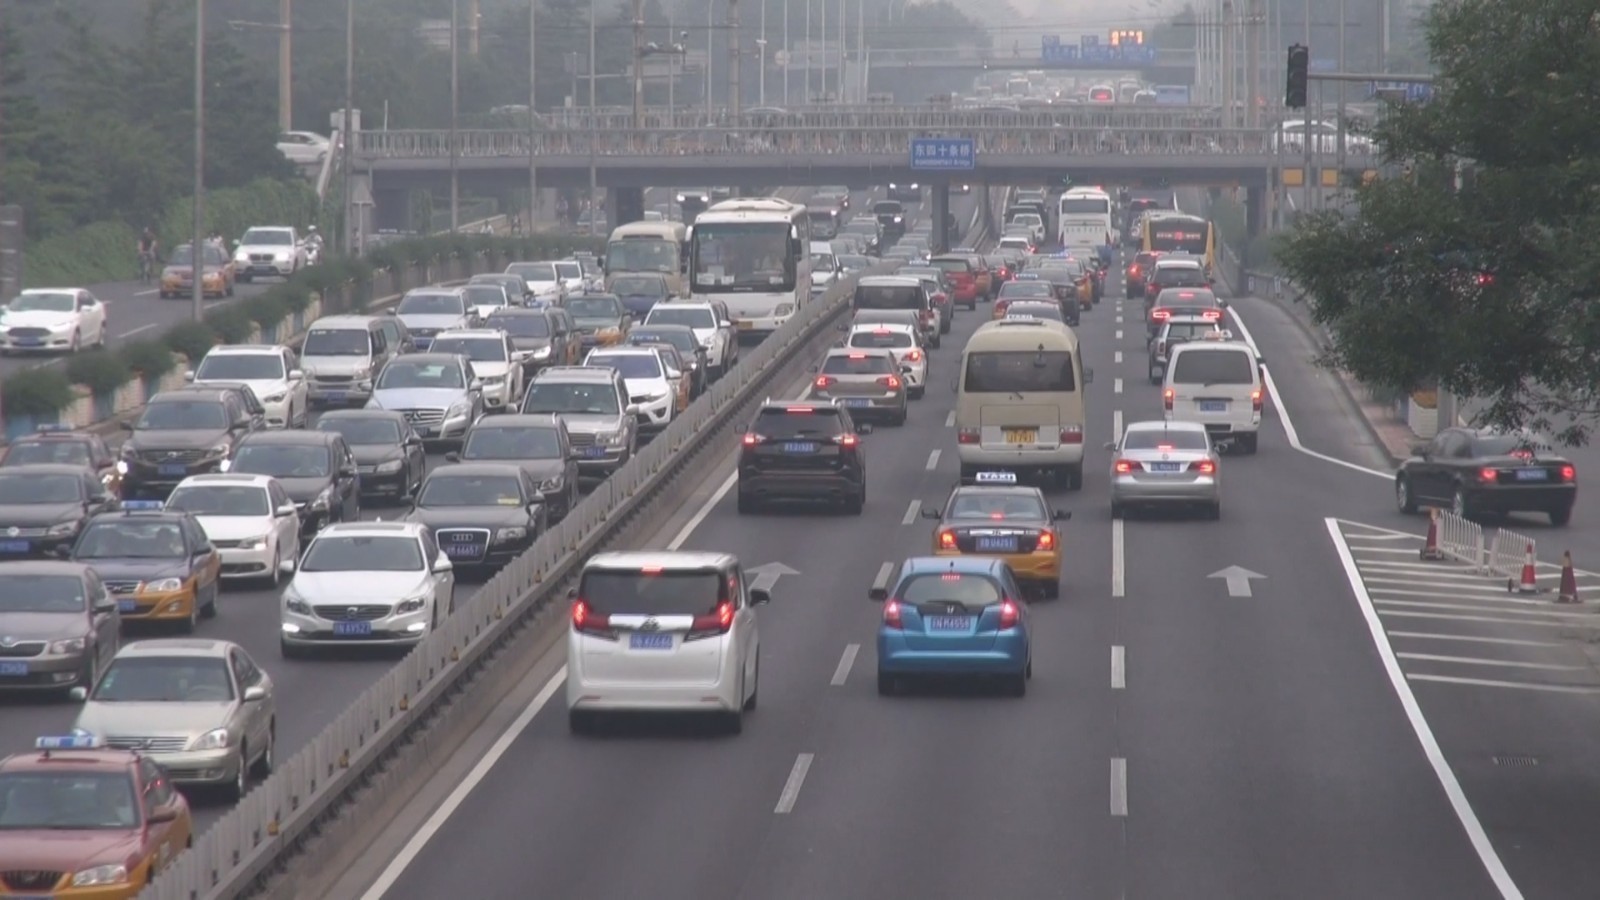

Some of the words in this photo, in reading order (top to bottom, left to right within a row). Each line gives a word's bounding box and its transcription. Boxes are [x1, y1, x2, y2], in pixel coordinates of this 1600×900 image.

[915, 144, 970, 157] 东四十条桥
